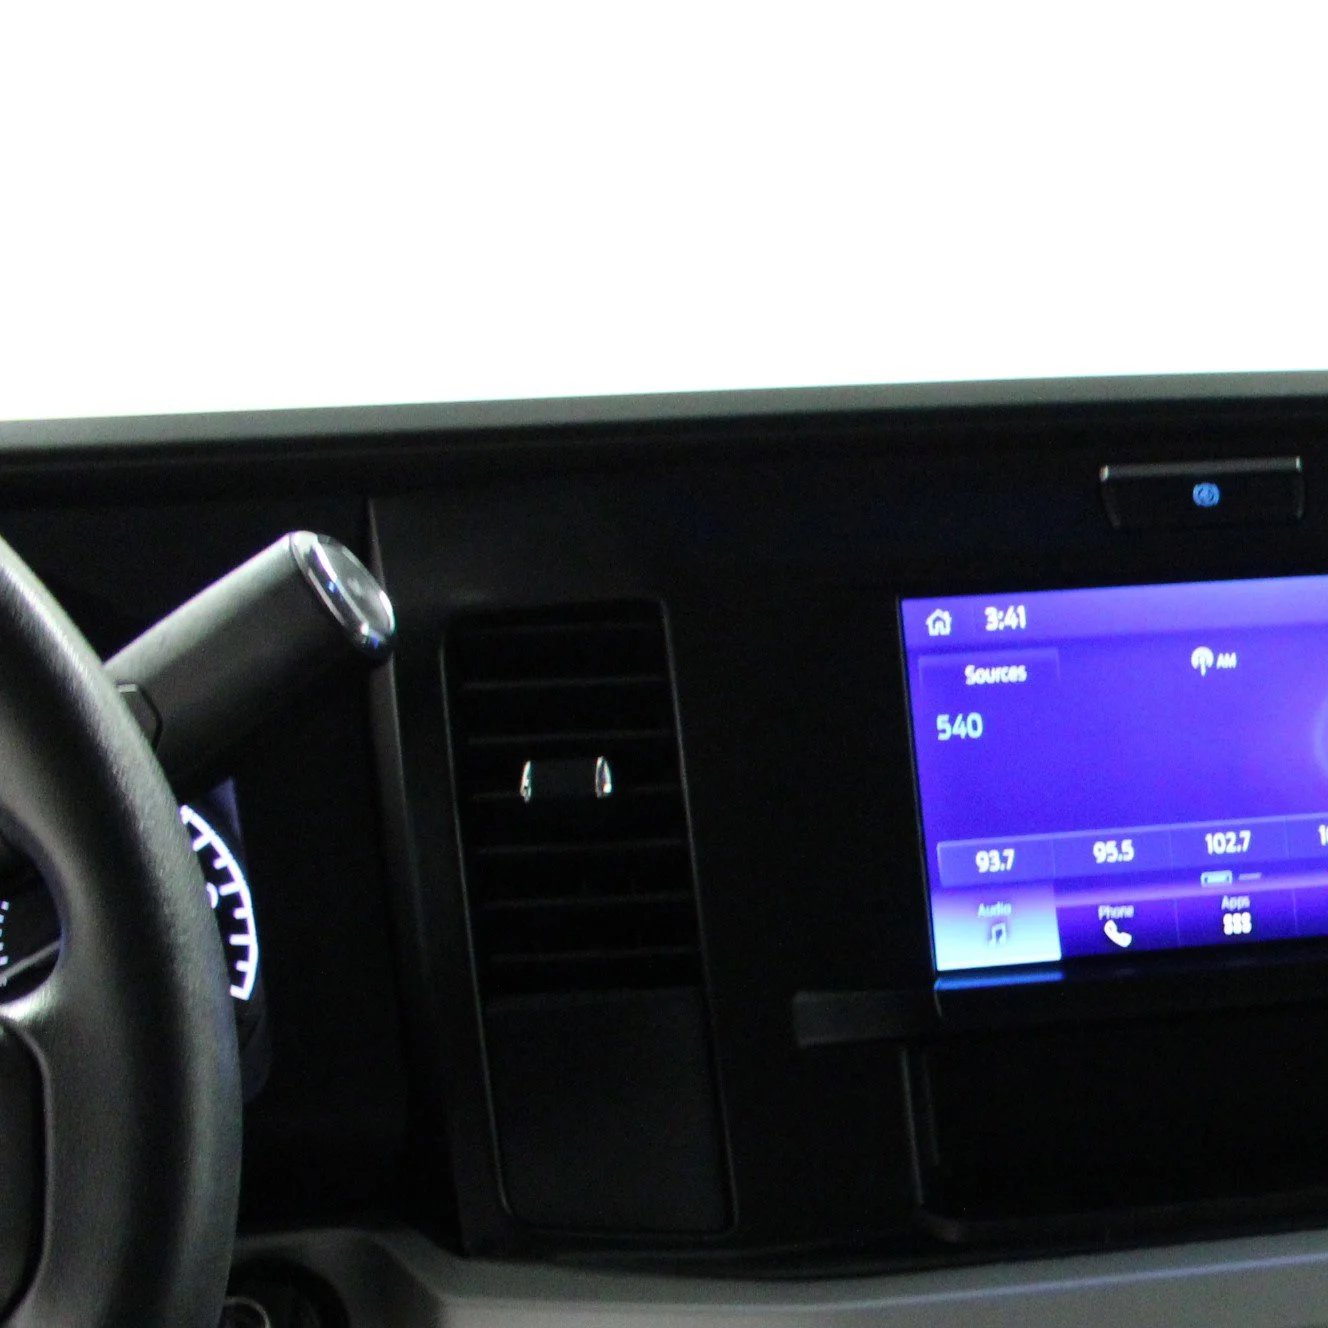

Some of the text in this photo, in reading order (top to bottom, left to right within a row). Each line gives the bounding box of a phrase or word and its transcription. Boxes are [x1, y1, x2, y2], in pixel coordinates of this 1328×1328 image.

[984, 605, 1027, 632] 3:41
[1216, 652, 1237, 669] AM
[964, 664, 1028, 686] Sources
[936, 712, 984, 741] 540
[1093, 839, 1135, 863] 95.5
[1205, 830, 1251, 855] 102.7
[975, 848, 1015, 873] 93.7
[977, 901, 1012, 917] Audio
[1098, 905, 1134, 920] Phone
[1221, 895, 1250, 912] Apps
